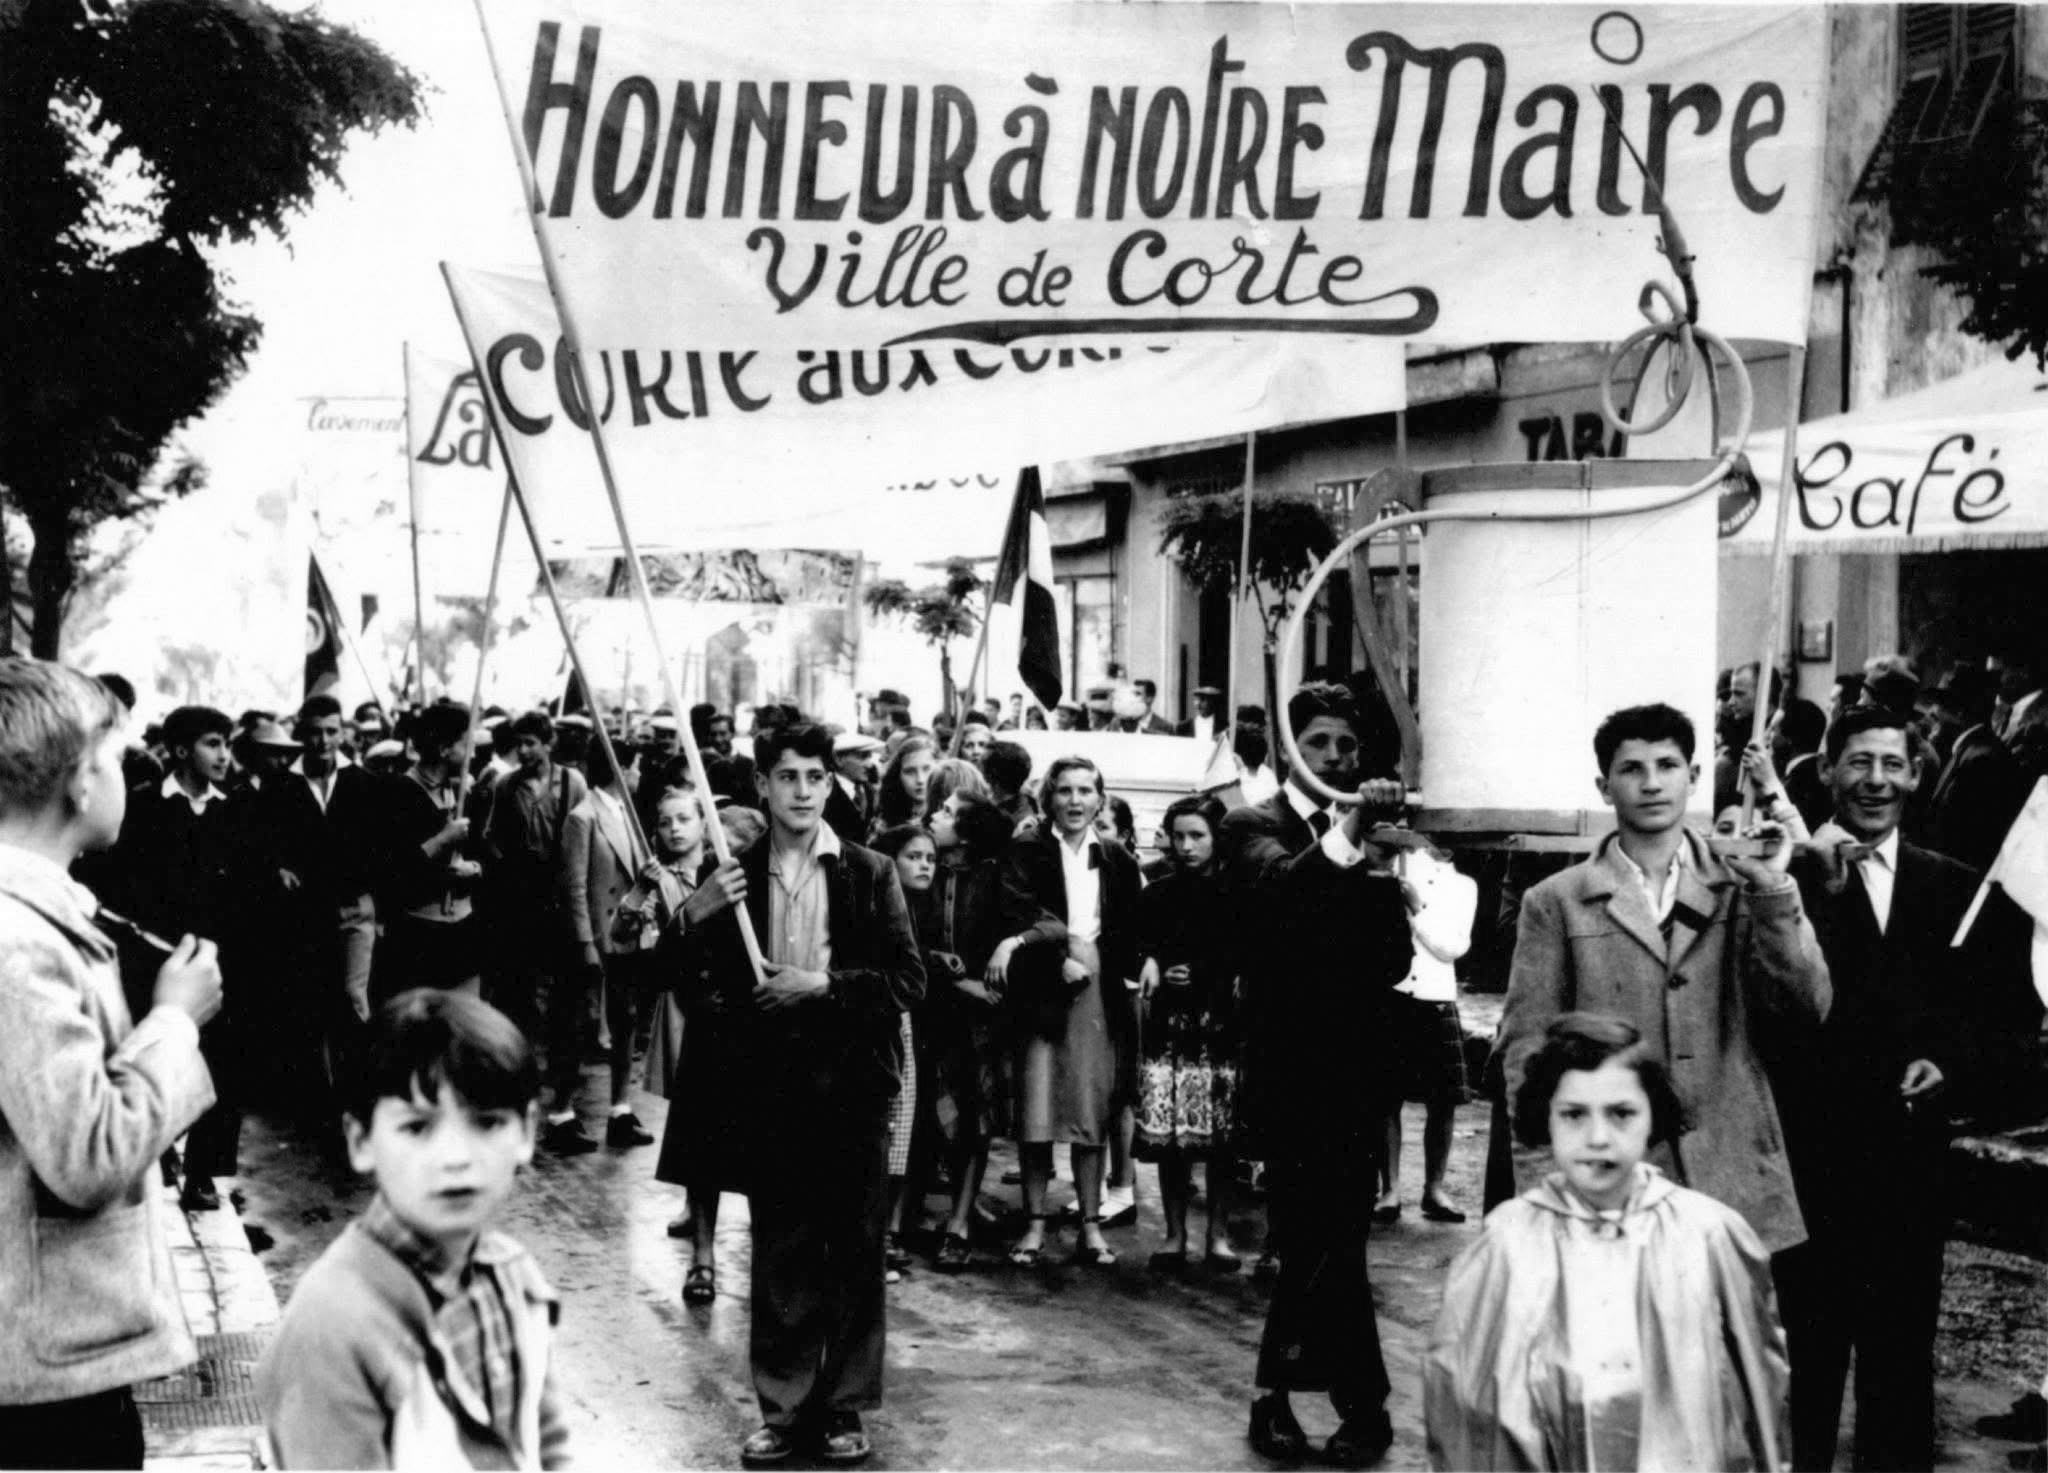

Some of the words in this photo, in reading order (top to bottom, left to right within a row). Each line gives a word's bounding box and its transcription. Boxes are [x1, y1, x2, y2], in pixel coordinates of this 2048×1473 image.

[523, 20, 986, 225] HONNEUR
[988, 70, 1060, 223] à
[1345, 10, 1787, 220] Maire
[746, 224, 970, 313] Ville
[997, 248, 1072, 307] de
[1107, 226, 1388, 309] Corte
[415, 370, 493, 471] La
[1792, 432, 2012, 536] Café
